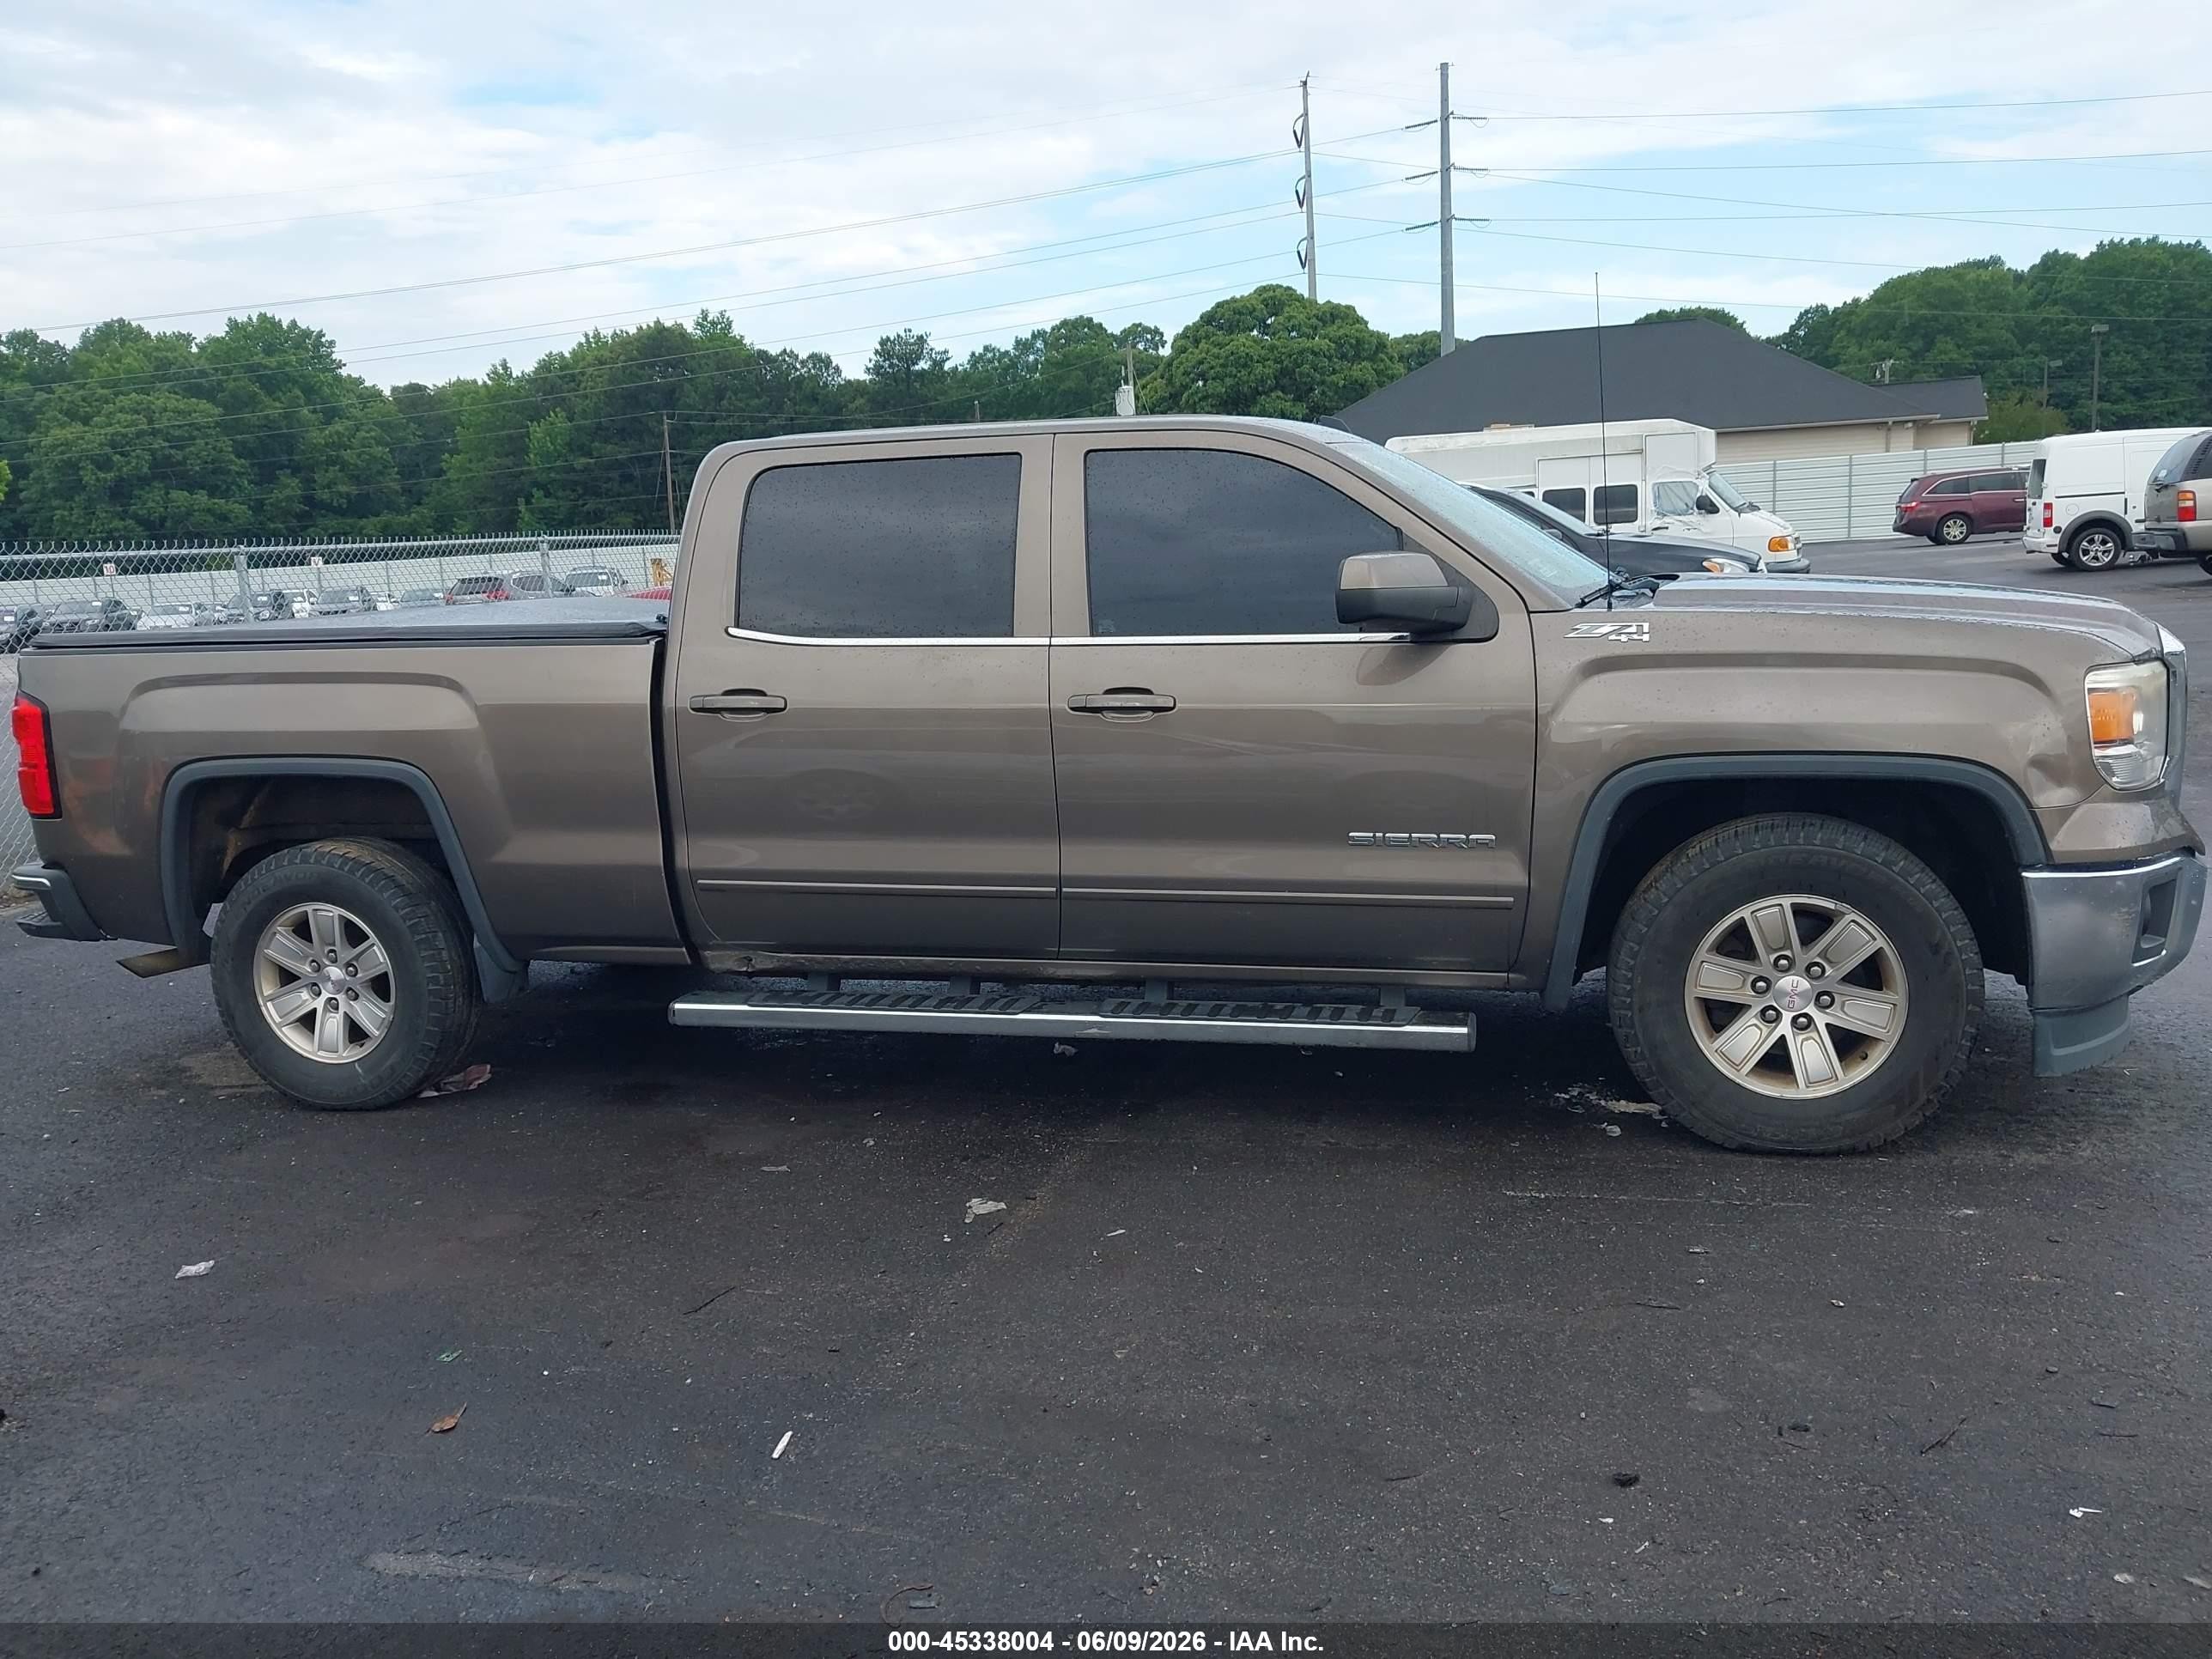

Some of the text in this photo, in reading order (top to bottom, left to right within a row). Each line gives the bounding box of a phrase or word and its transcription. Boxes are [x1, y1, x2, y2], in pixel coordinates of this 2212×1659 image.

[1563, 622, 1650, 639] Z71
[1347, 831, 1497, 848] SIERRA
[1787, 979, 1800, 1009] GMC
